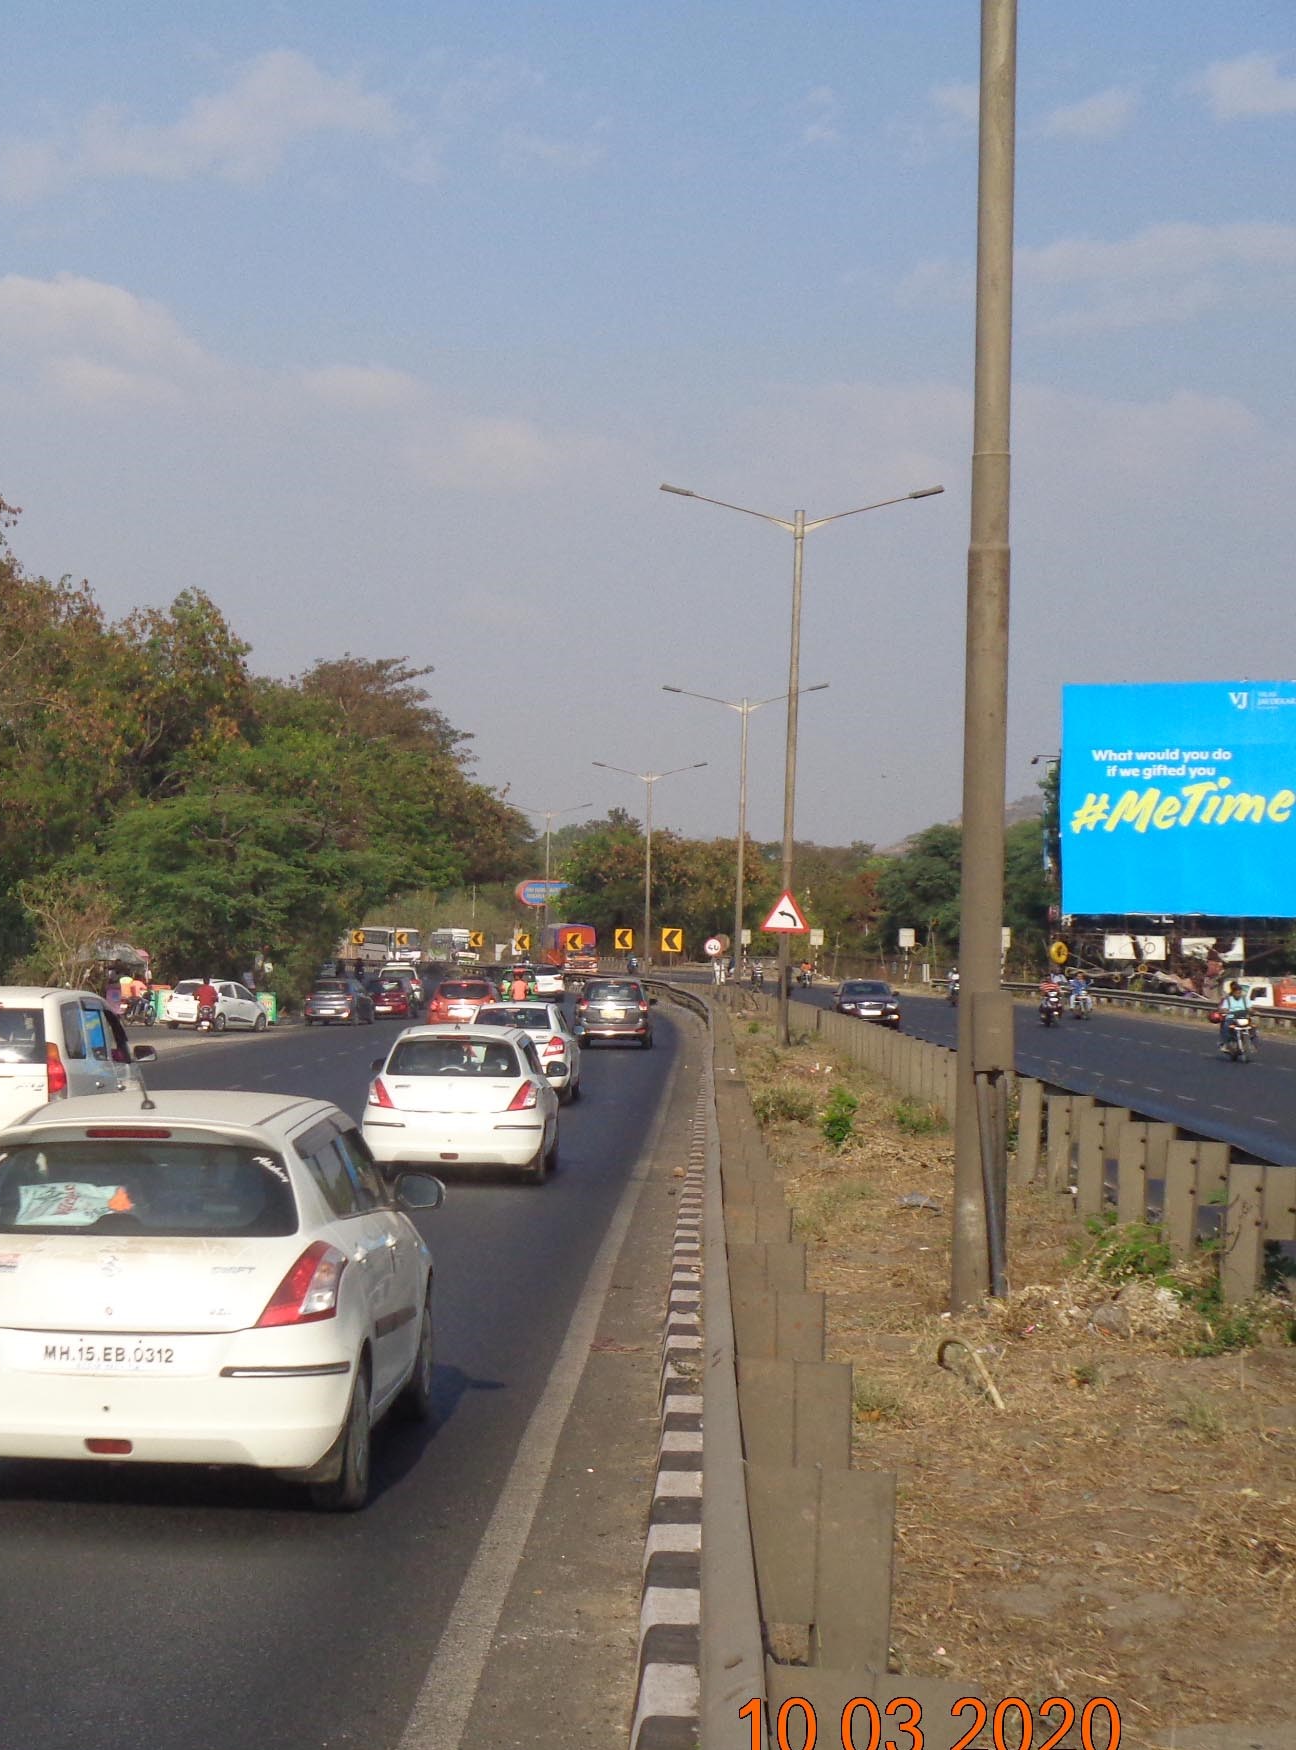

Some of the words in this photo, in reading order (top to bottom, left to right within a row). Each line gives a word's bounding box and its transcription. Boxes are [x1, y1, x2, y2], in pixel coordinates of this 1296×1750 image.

[1228, 691, 1249, 710] VJ
[1092, 749, 1134, 761] What
[1136, 748, 1180, 761] would
[1183, 751, 1209, 764] you
[1212, 748, 1232, 761] do
[1107, 765, 1117, 777] if
[1120, 766, 1140, 777] we
[1143, 764, 1187, 780] gifted
[1189, 767, 1216, 779] you
[1070, 777, 1296, 834] #MeTime
